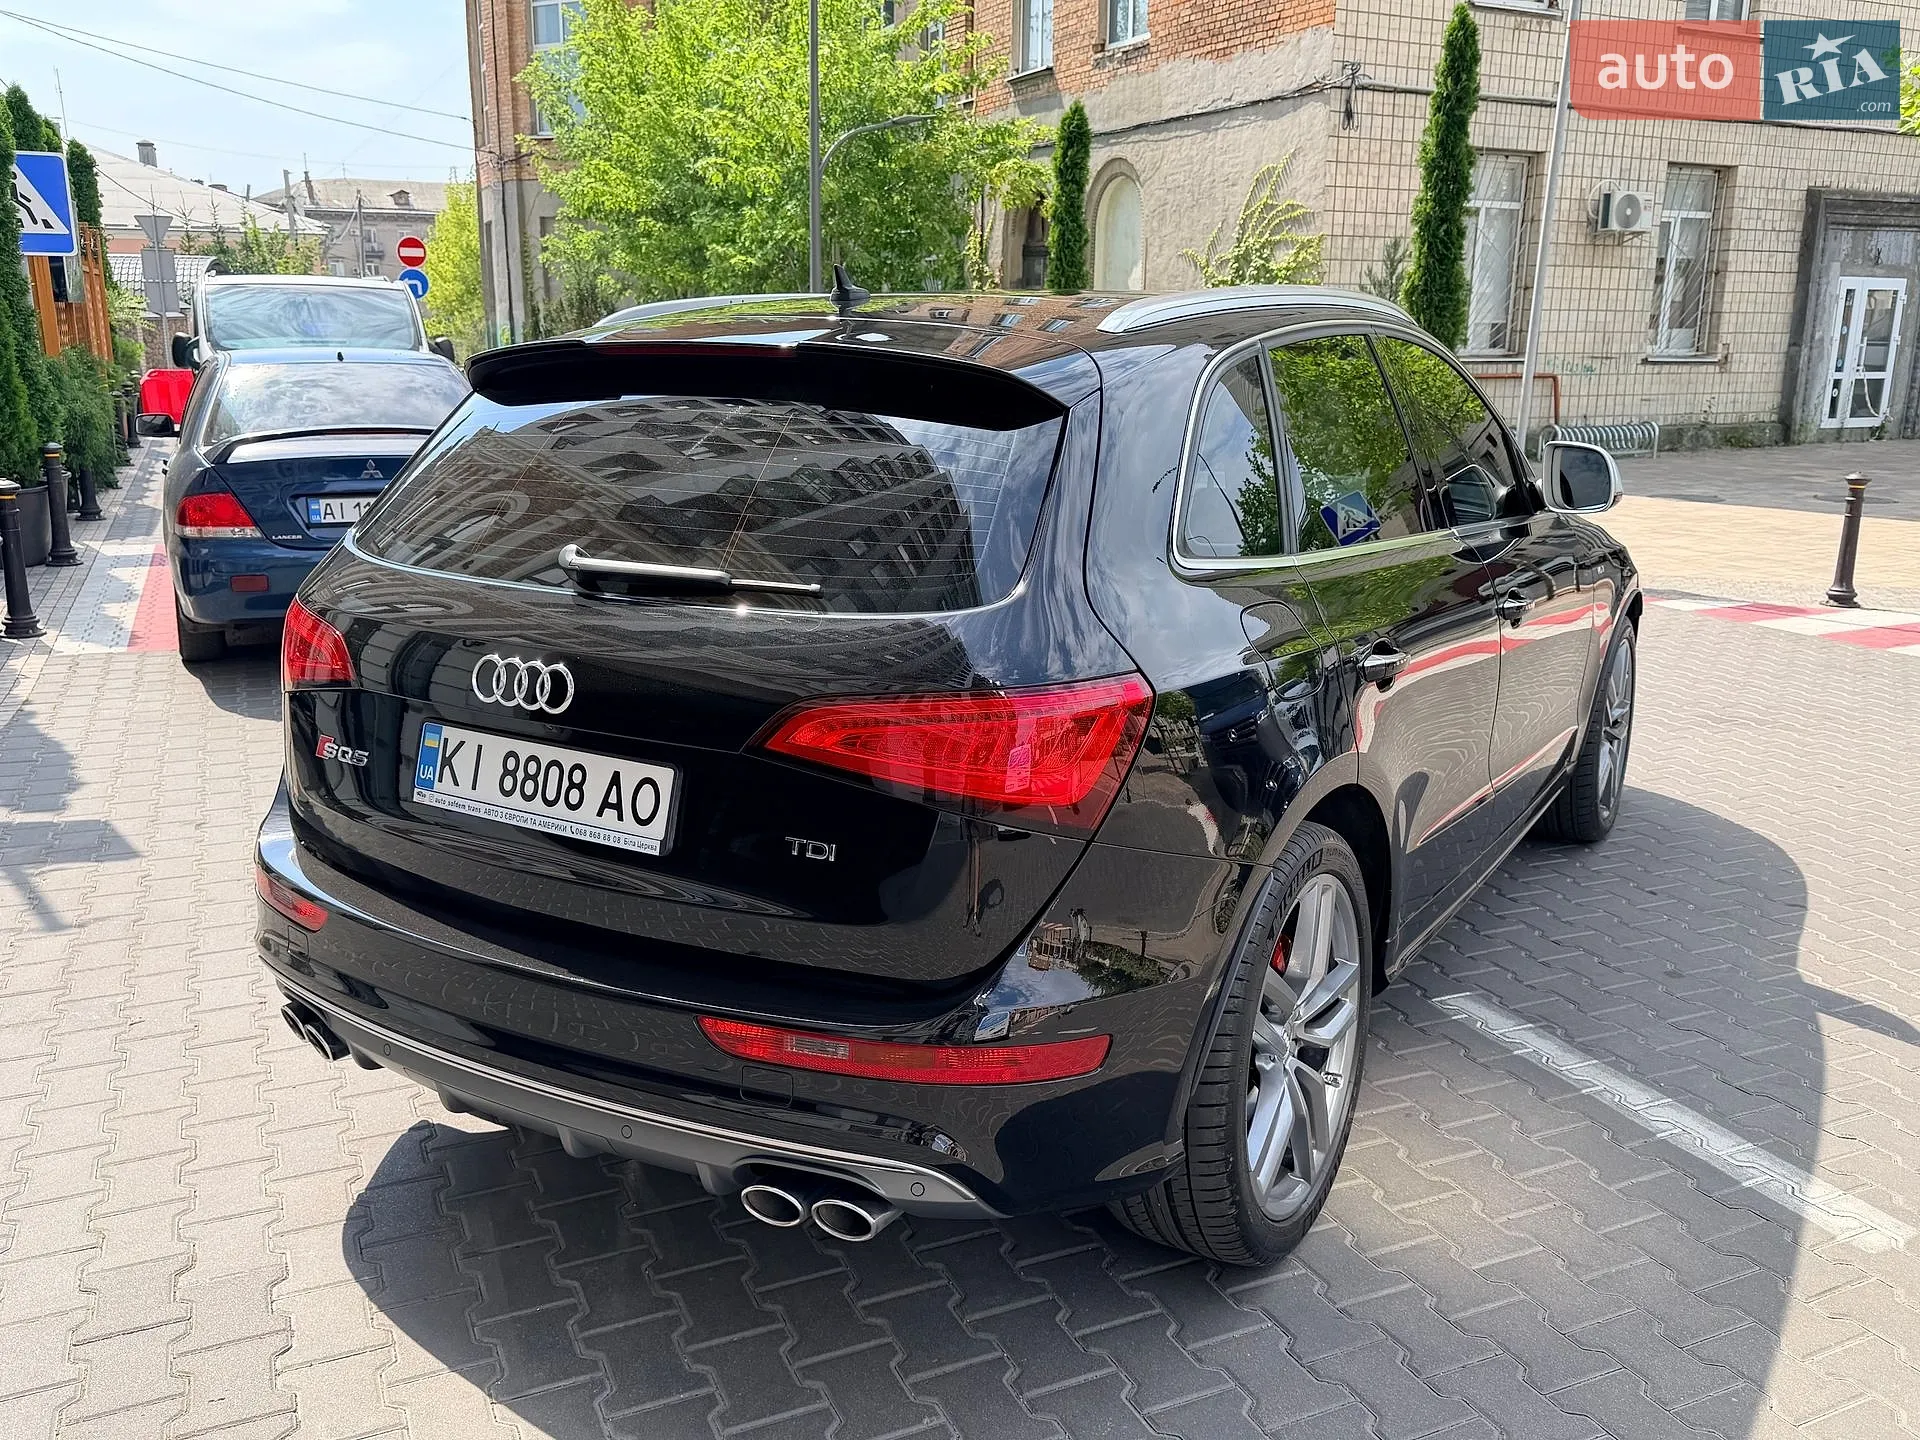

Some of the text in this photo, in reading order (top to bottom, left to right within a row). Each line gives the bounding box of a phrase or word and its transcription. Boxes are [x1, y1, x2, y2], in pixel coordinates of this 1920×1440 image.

[323, 502, 345, 520] AI
[321, 738, 370, 767] SQ5
[419, 764, 434, 781] UA
[437, 737, 661, 827] KI 8808 AO
[785, 836, 836, 862] TDI
